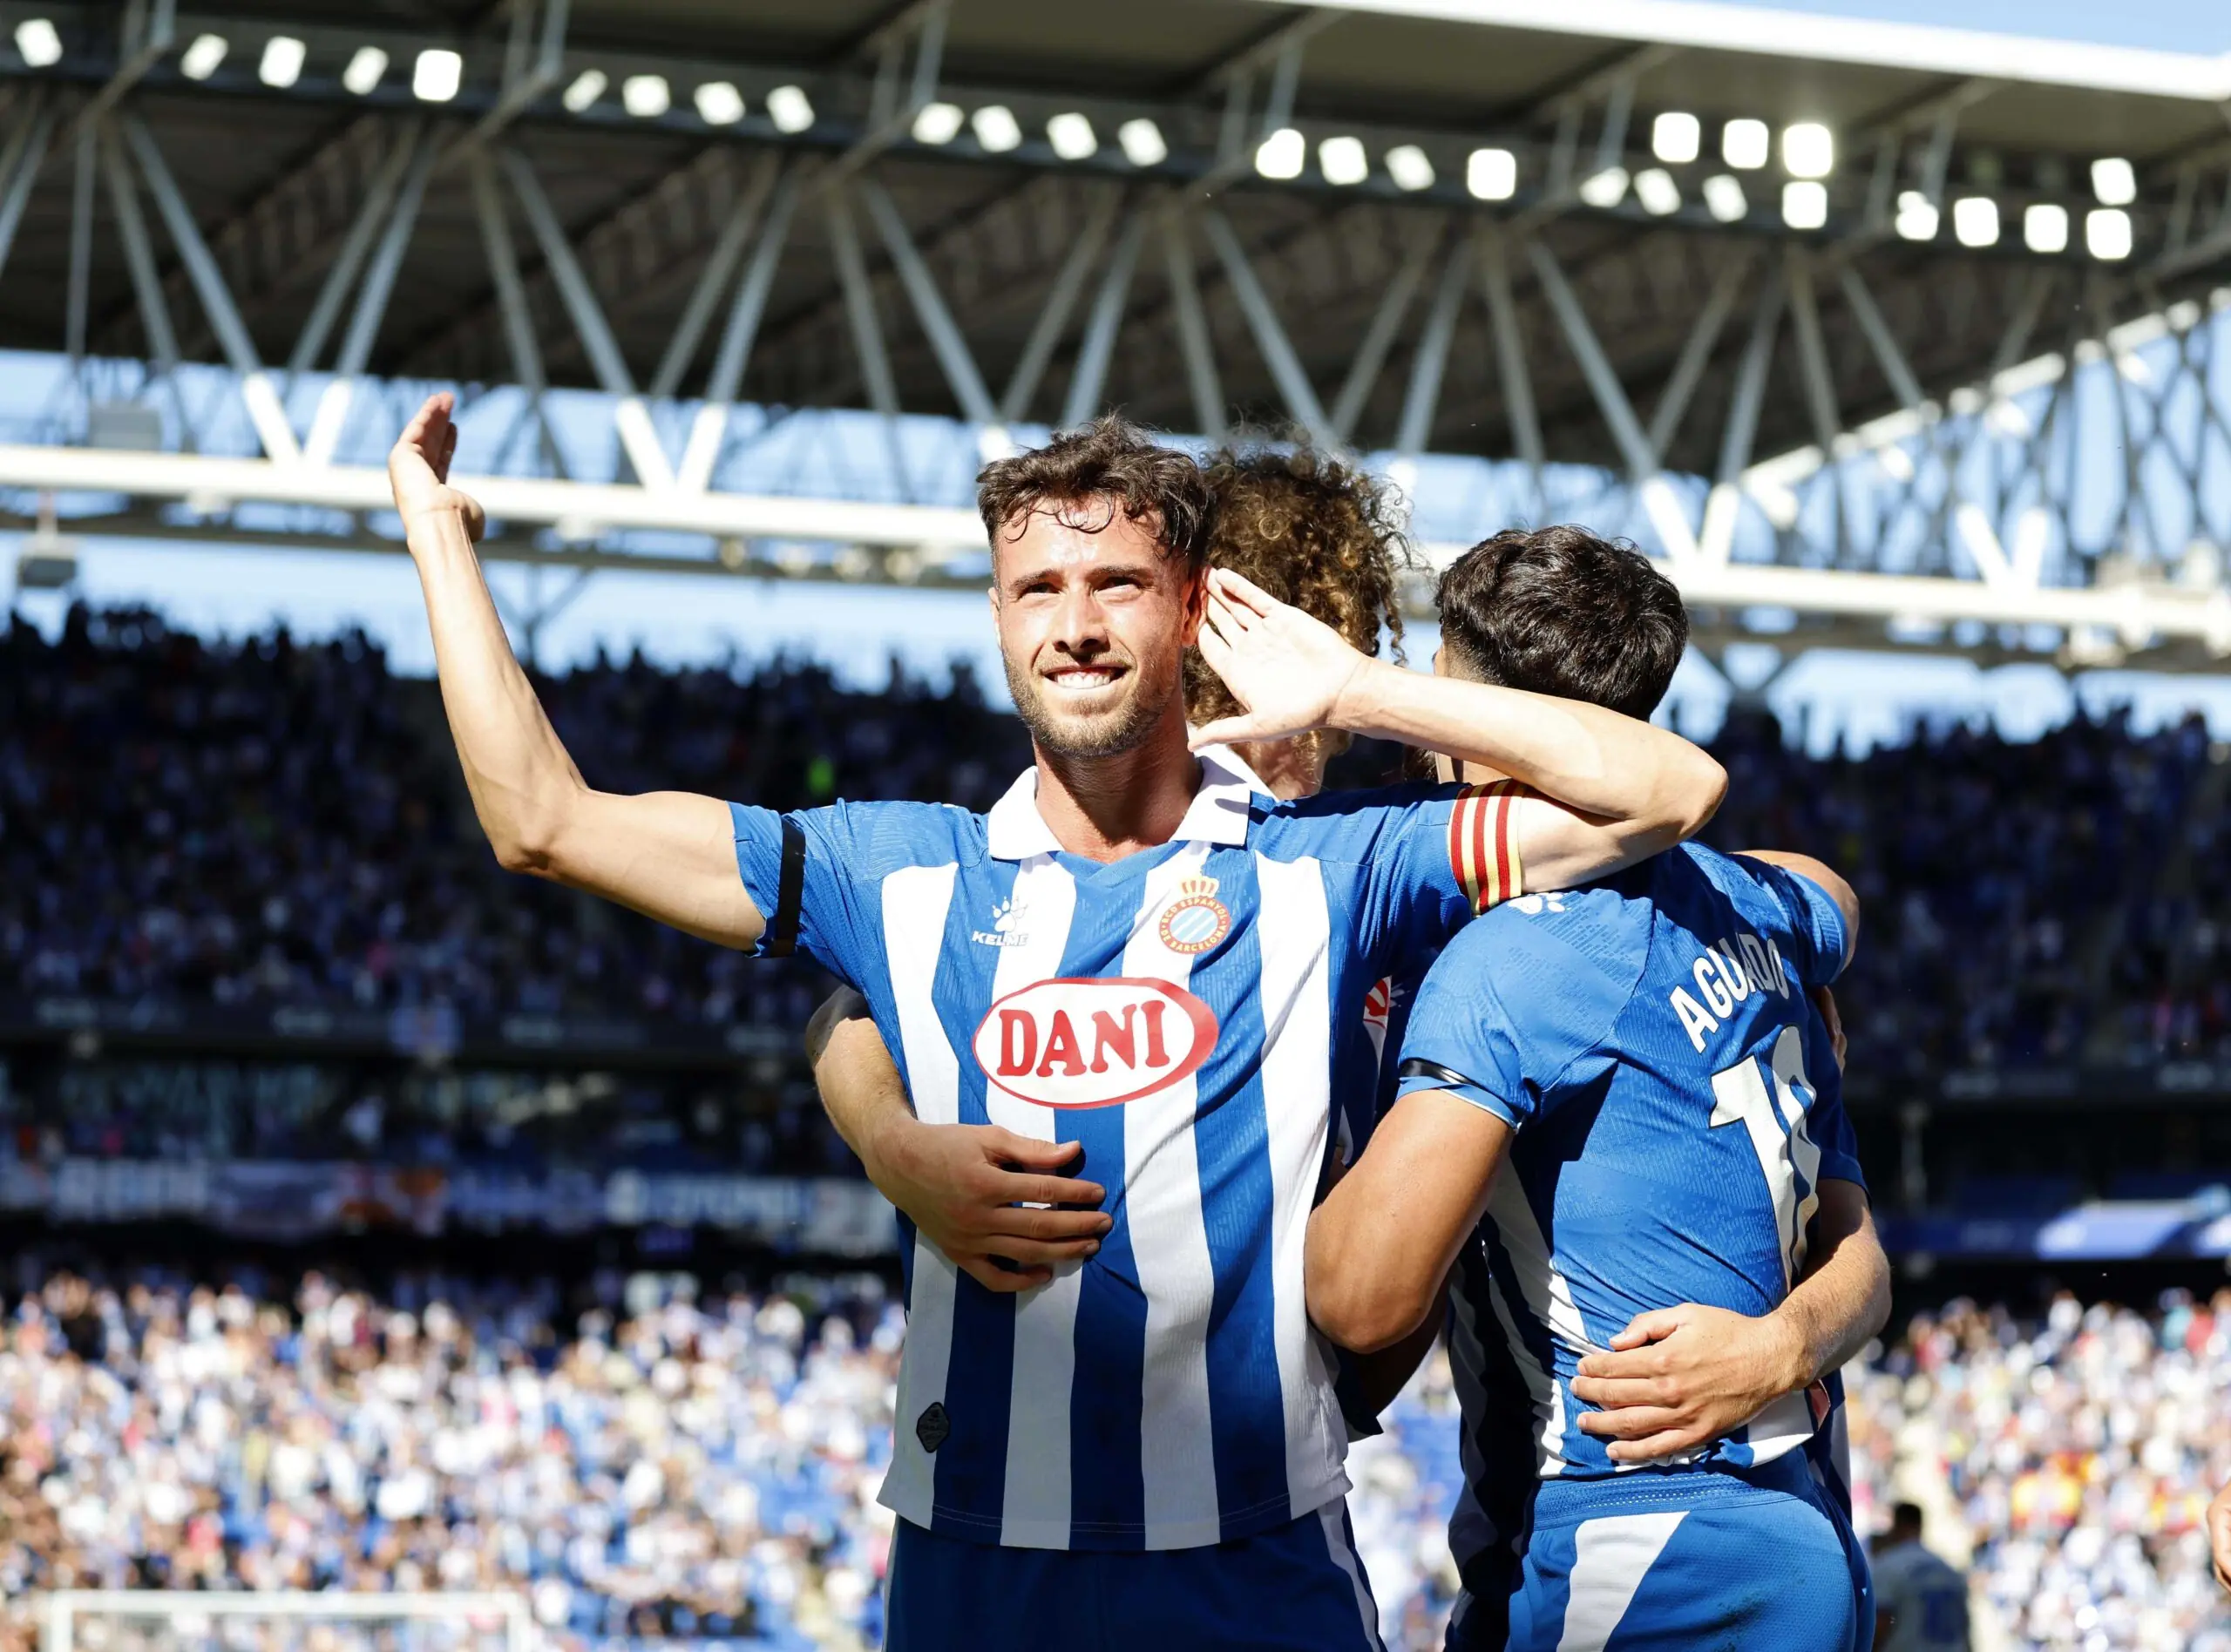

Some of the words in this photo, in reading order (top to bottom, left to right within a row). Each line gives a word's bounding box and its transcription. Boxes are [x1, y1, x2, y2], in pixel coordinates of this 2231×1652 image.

[1179, 897, 1229, 920] ESPANYOL
[971, 930, 1029, 947] KELME
[1170, 924, 1228, 952] BARCELONA
[1669, 933, 1789, 1053] AGUADO
[996, 999, 1170, 1078] DANI
